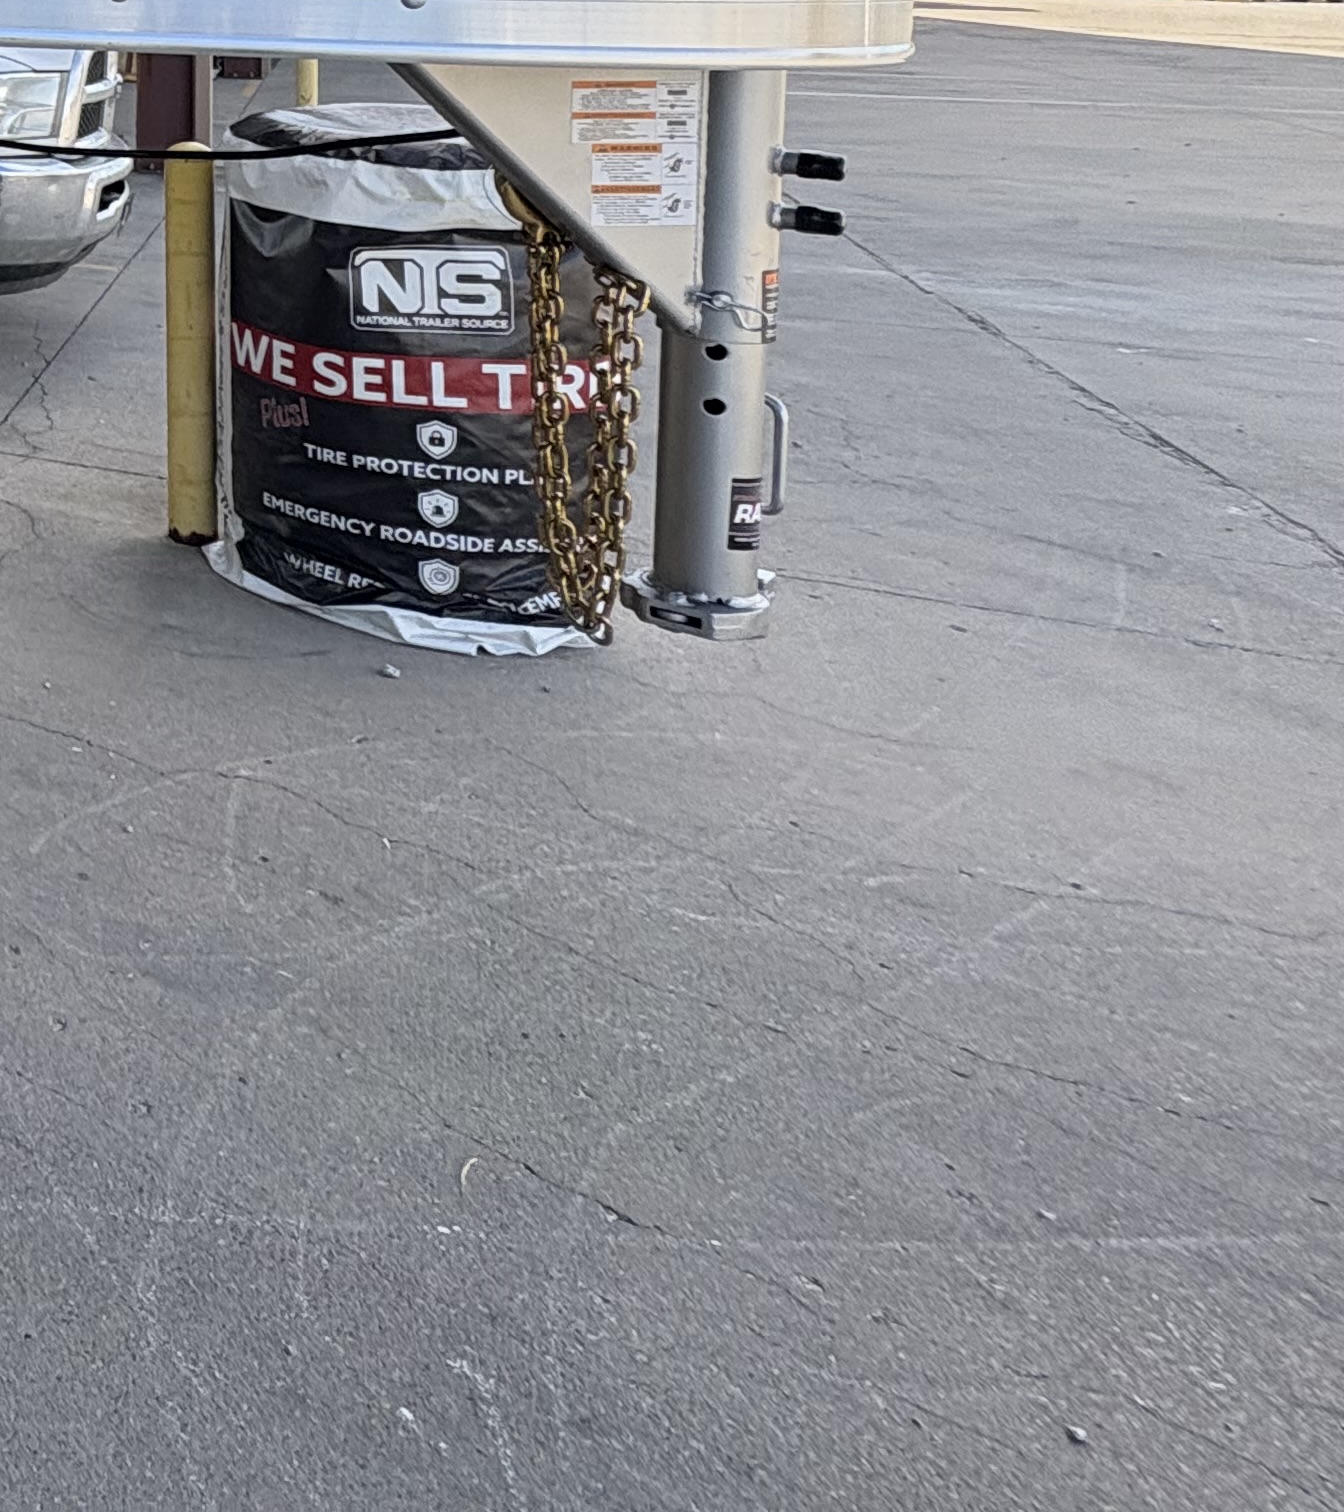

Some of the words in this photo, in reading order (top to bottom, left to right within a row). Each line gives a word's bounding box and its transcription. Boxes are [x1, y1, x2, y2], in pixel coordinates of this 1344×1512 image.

[354, 250, 506, 316] NTS
[356, 315, 411, 327] NATIONAL
[412, 316, 459, 328] TRAILER
[461, 318, 509, 329] SOURCE
[232, 322, 297, 387] WE
[313, 352, 468, 409] SELL
[260, 396, 310, 428] Plus!
[303, 442, 349, 467] TIRE
[352, 454, 499, 485] PROTECTION
[263, 491, 376, 537] EMERGENCY
[380, 525, 494, 553] ROADSIDE
[283, 552, 345, 585] WHEEL
